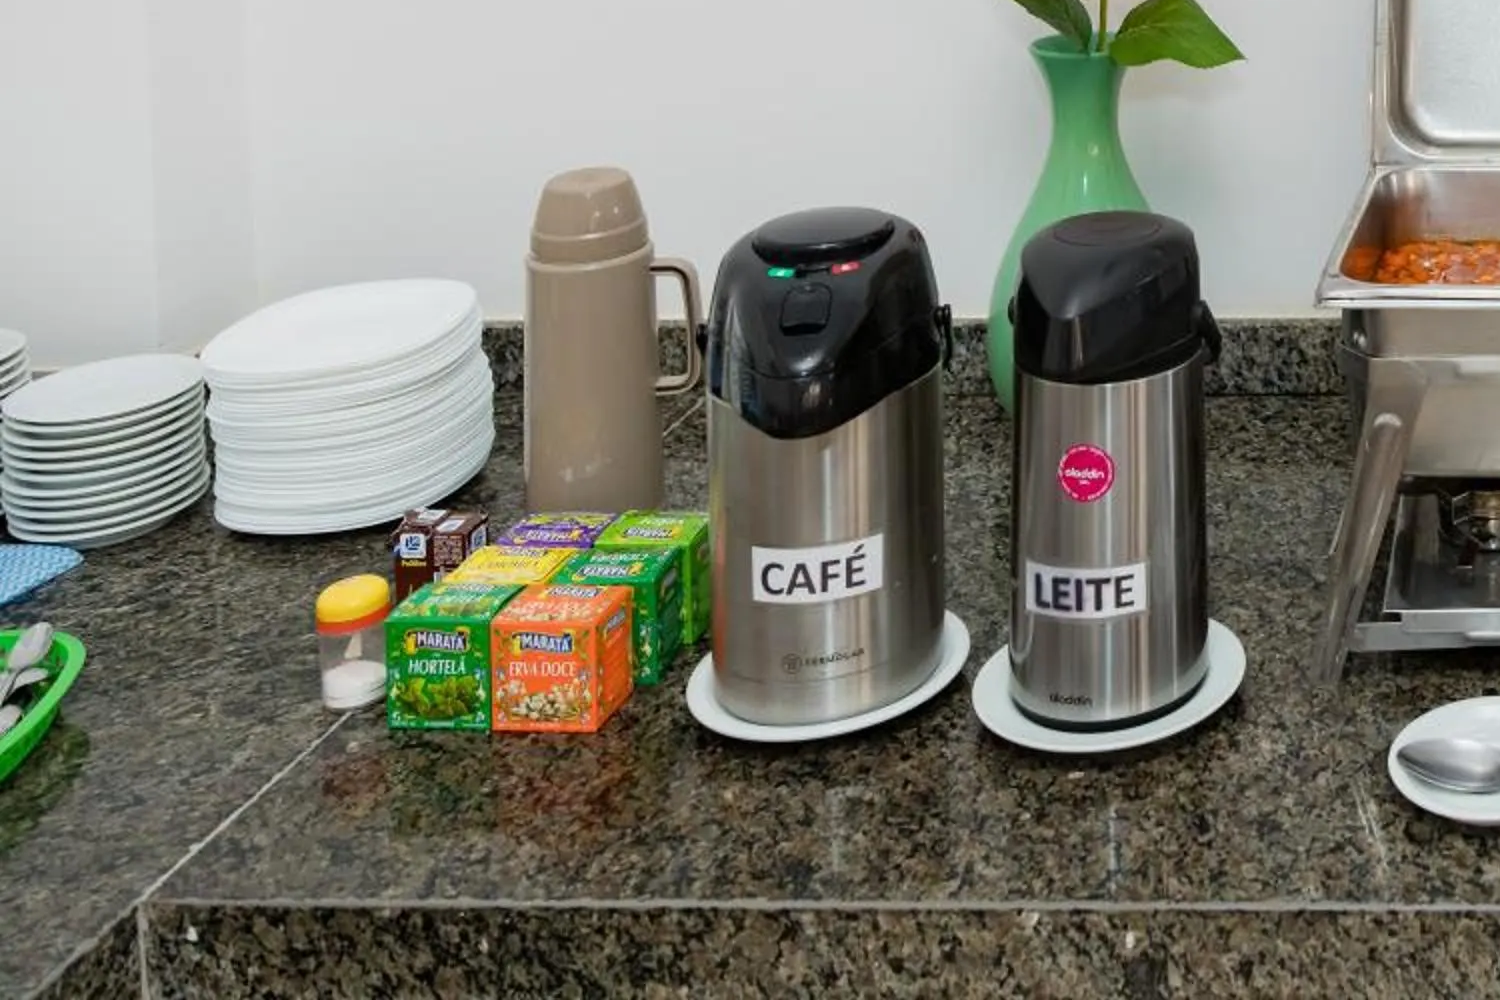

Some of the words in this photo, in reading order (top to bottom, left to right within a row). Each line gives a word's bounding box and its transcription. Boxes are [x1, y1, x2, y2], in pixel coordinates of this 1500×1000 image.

[760, 543, 867, 596] CAFÉ
[1033, 572, 1136, 613] LEITE
[541, 660, 577, 678] DOCE
